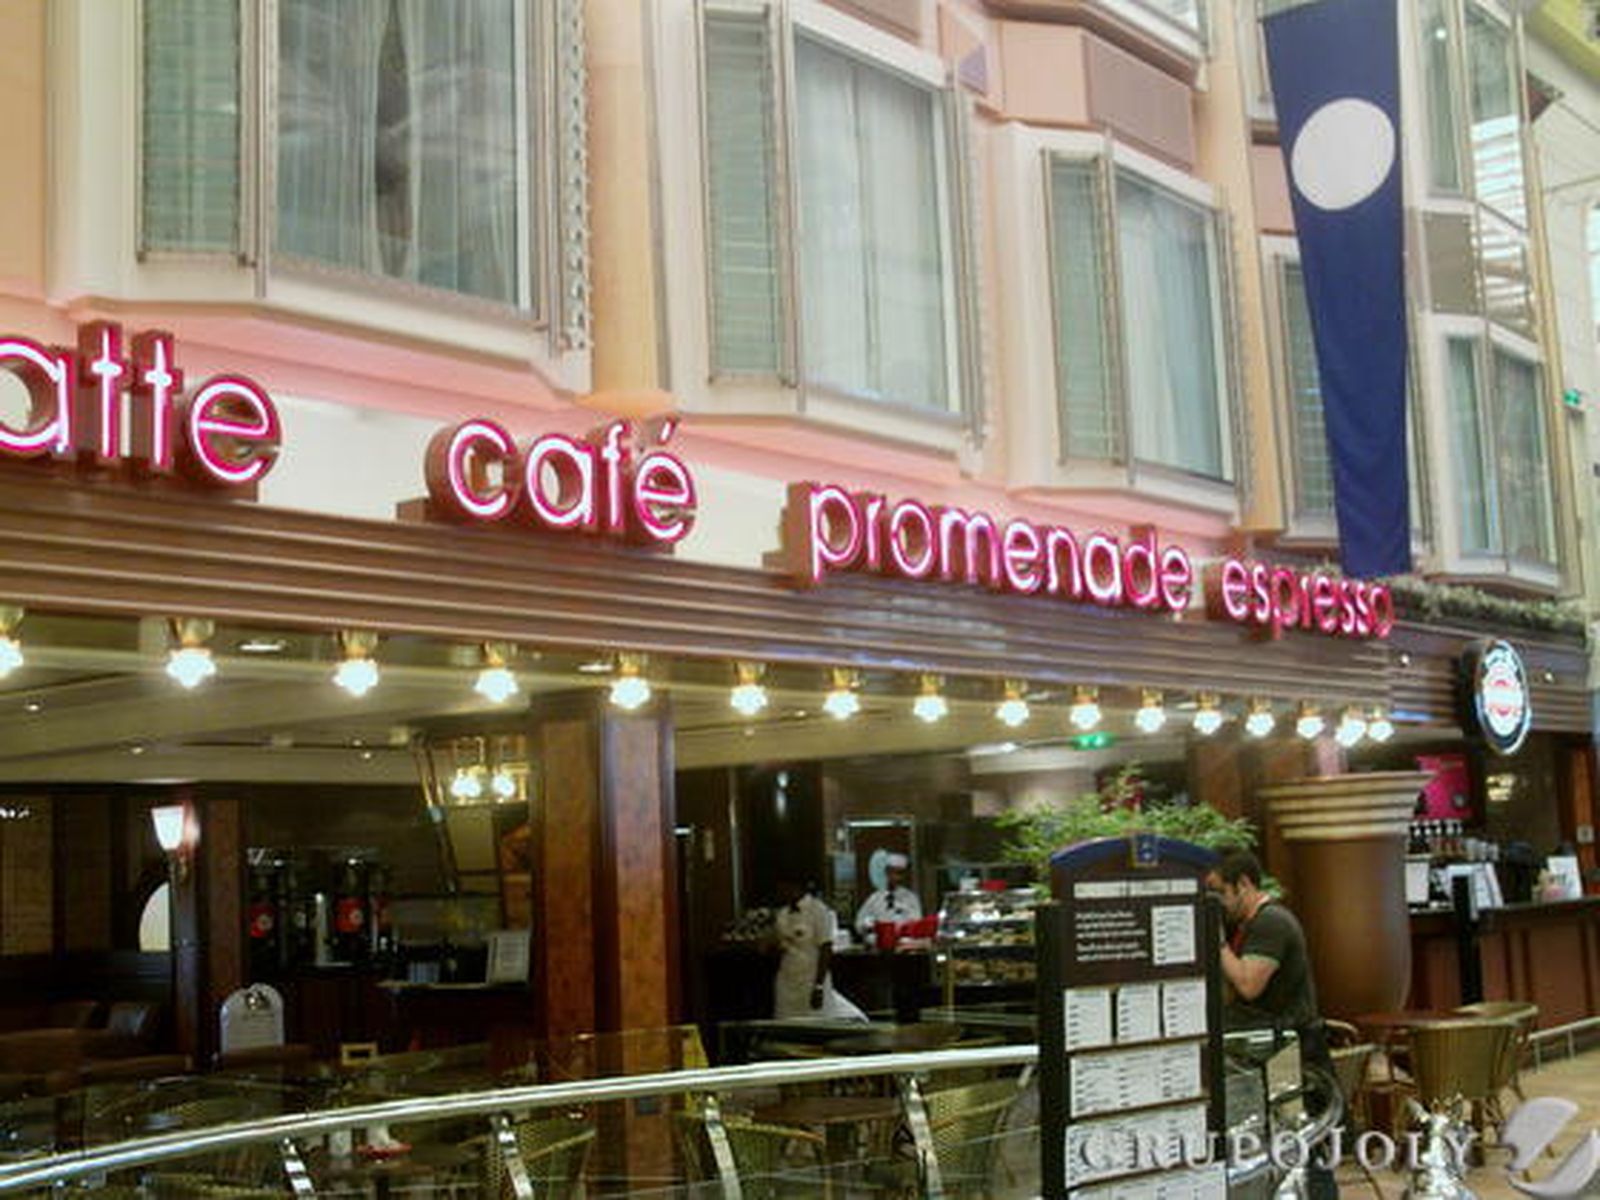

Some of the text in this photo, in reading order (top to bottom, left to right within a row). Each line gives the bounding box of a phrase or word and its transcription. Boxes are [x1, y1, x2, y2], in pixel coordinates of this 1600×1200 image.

[445, 416, 698, 542] café
[806, 483, 1192, 611] promenade
[1222, 558, 1394, 639] espresso
